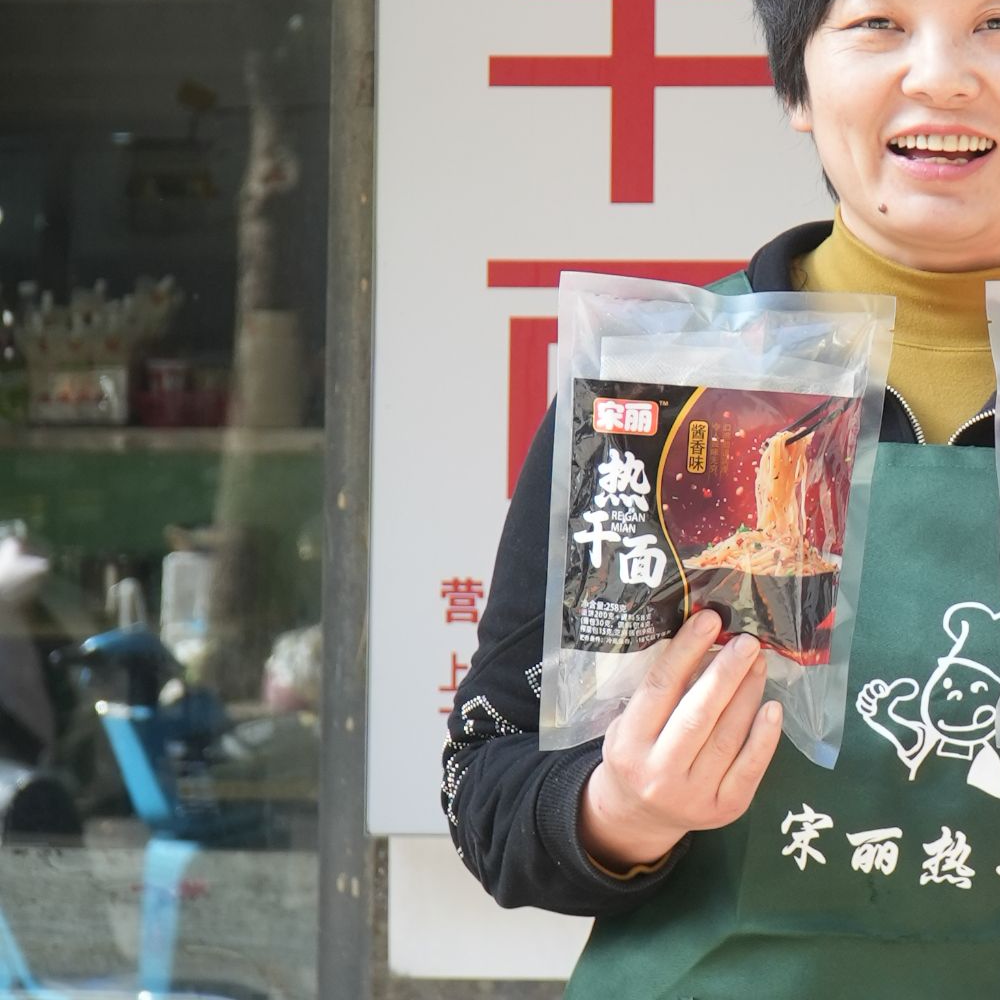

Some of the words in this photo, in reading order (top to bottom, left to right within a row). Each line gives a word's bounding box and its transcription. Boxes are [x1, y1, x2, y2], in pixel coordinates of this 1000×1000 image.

[596, 400, 653, 433] 宋丽
[689, 423, 707, 471] 酱香味
[611, 510, 623, 522] RE
[625, 511, 646, 523] GAN
[611, 522, 637, 534] MIAN
[441, 577, 484, 623] 营
